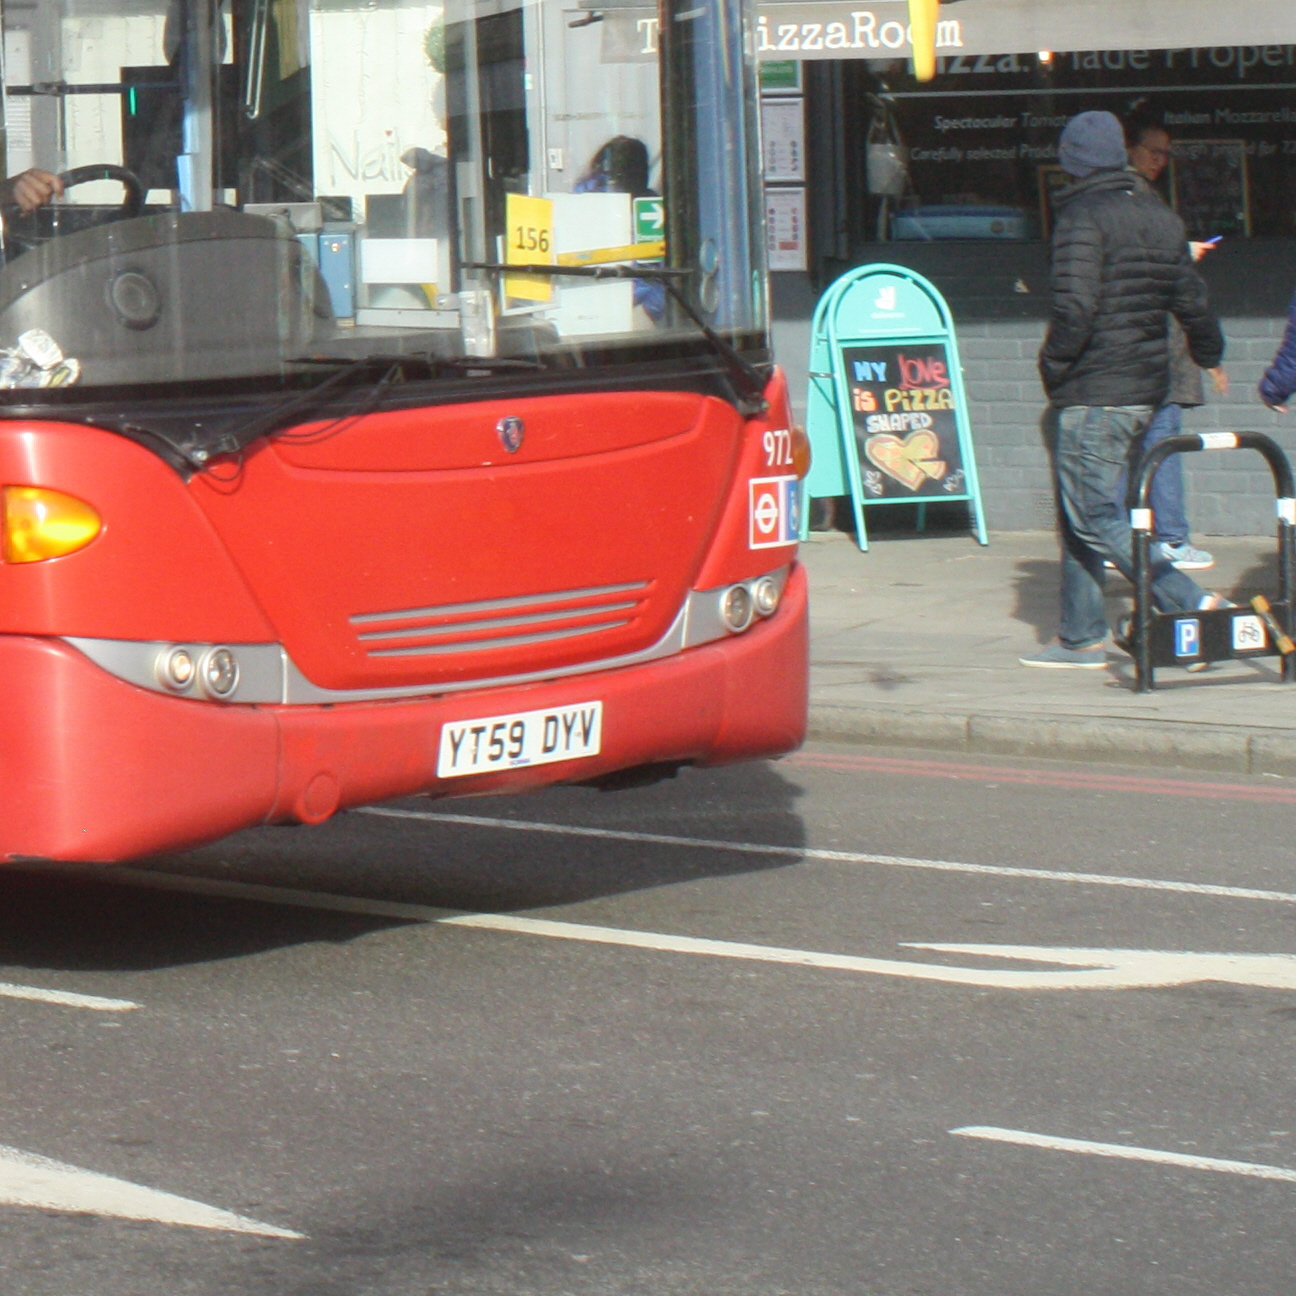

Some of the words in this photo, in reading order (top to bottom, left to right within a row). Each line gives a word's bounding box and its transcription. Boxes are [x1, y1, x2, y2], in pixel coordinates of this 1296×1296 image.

[744, 11, 964, 53] izzaRom
[516, 225, 550, 254] 156
[853, 360, 888, 382] MY
[865, 411, 933, 433] SHAPED
[763, 429, 793, 466] 972
[1179, 624, 1197, 652] P
[449, 719, 526, 768] YT59
[541, 708, 597, 754] DYV
